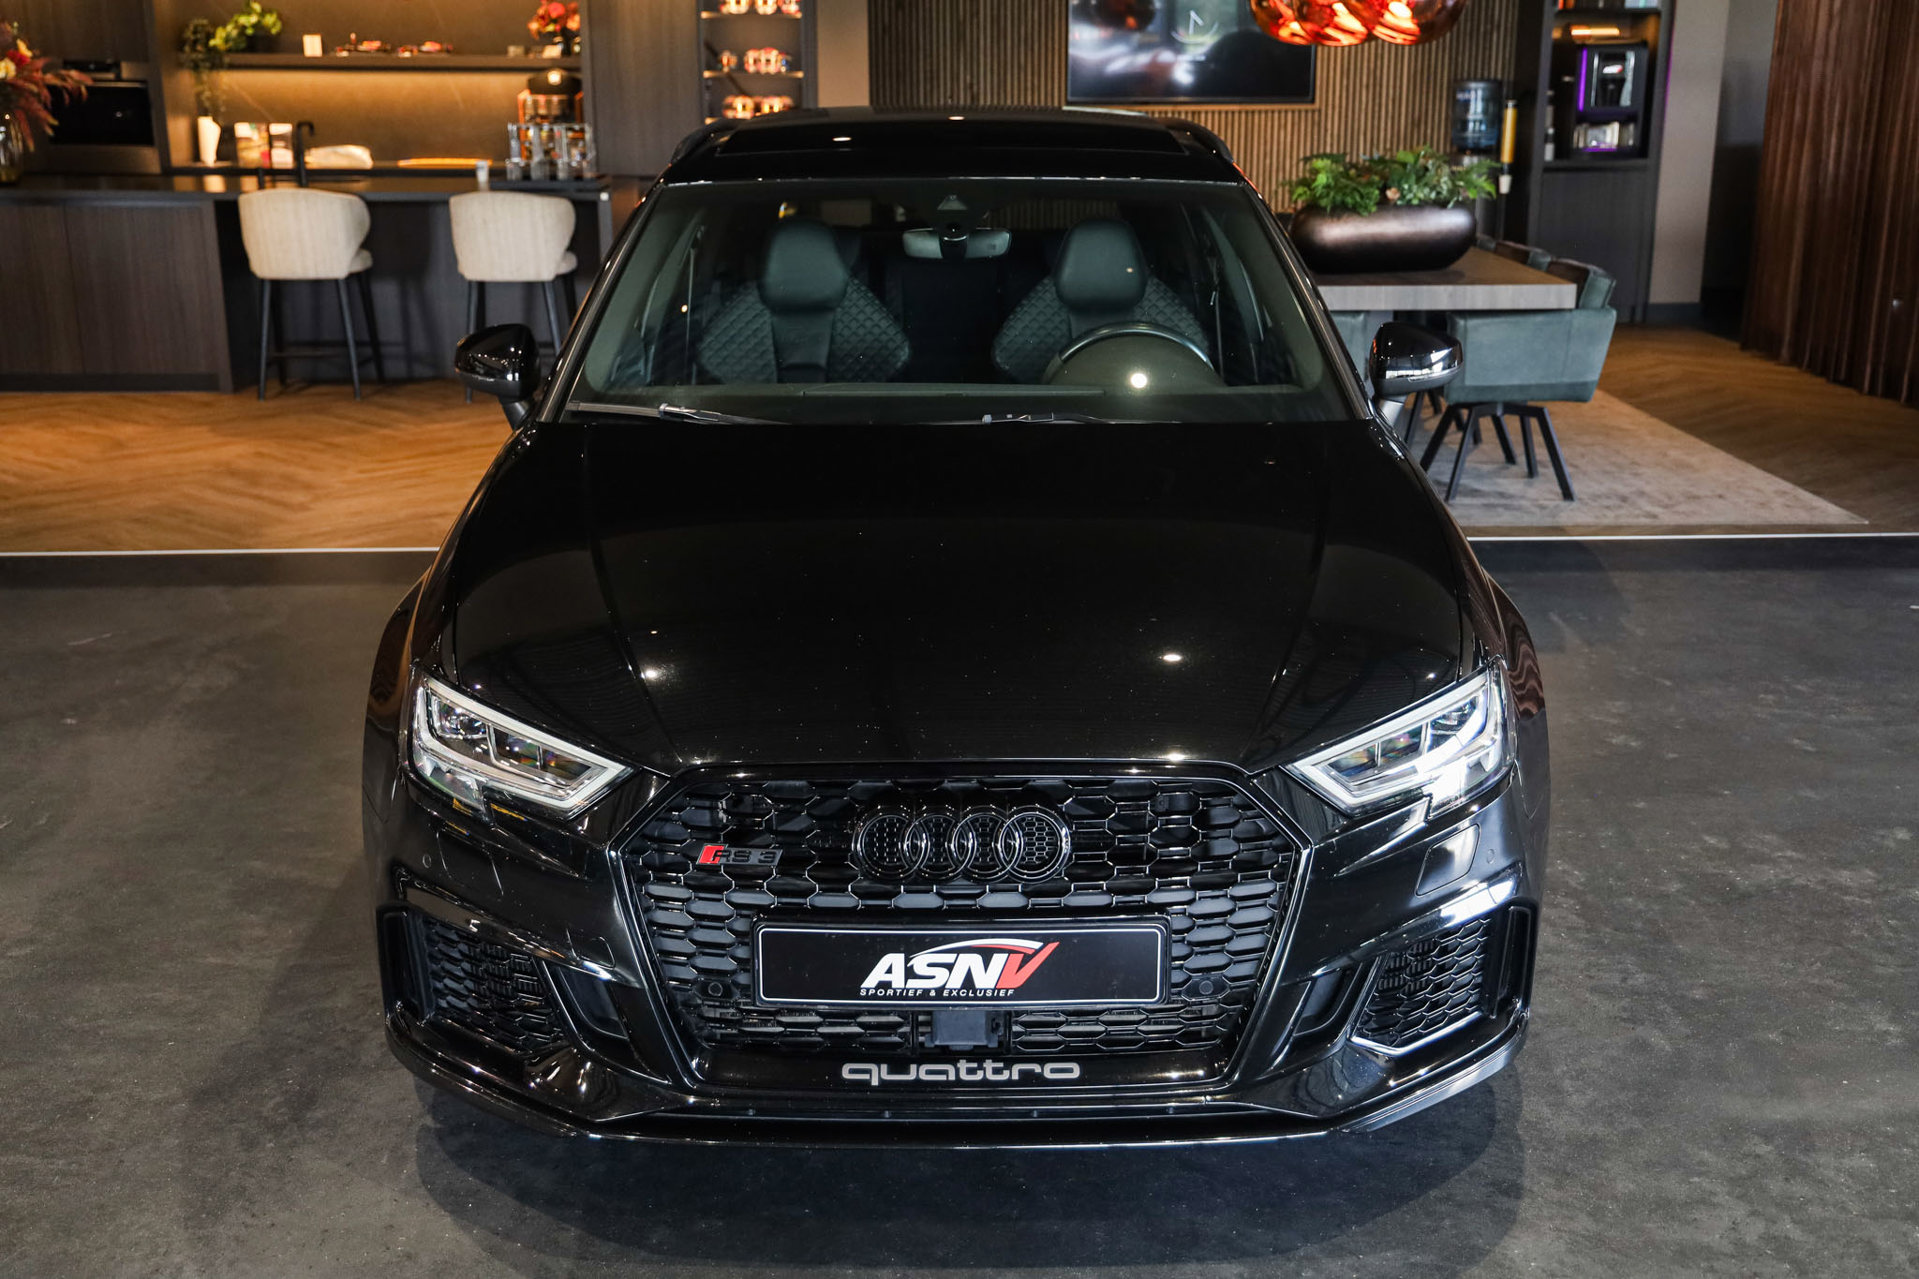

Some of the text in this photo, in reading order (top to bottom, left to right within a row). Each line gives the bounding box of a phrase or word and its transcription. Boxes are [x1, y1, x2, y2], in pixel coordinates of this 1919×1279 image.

[860, 988, 1015, 997] SPORTIEF & EXCLUSIEF
[841, 1059, 1081, 1086] quattro
